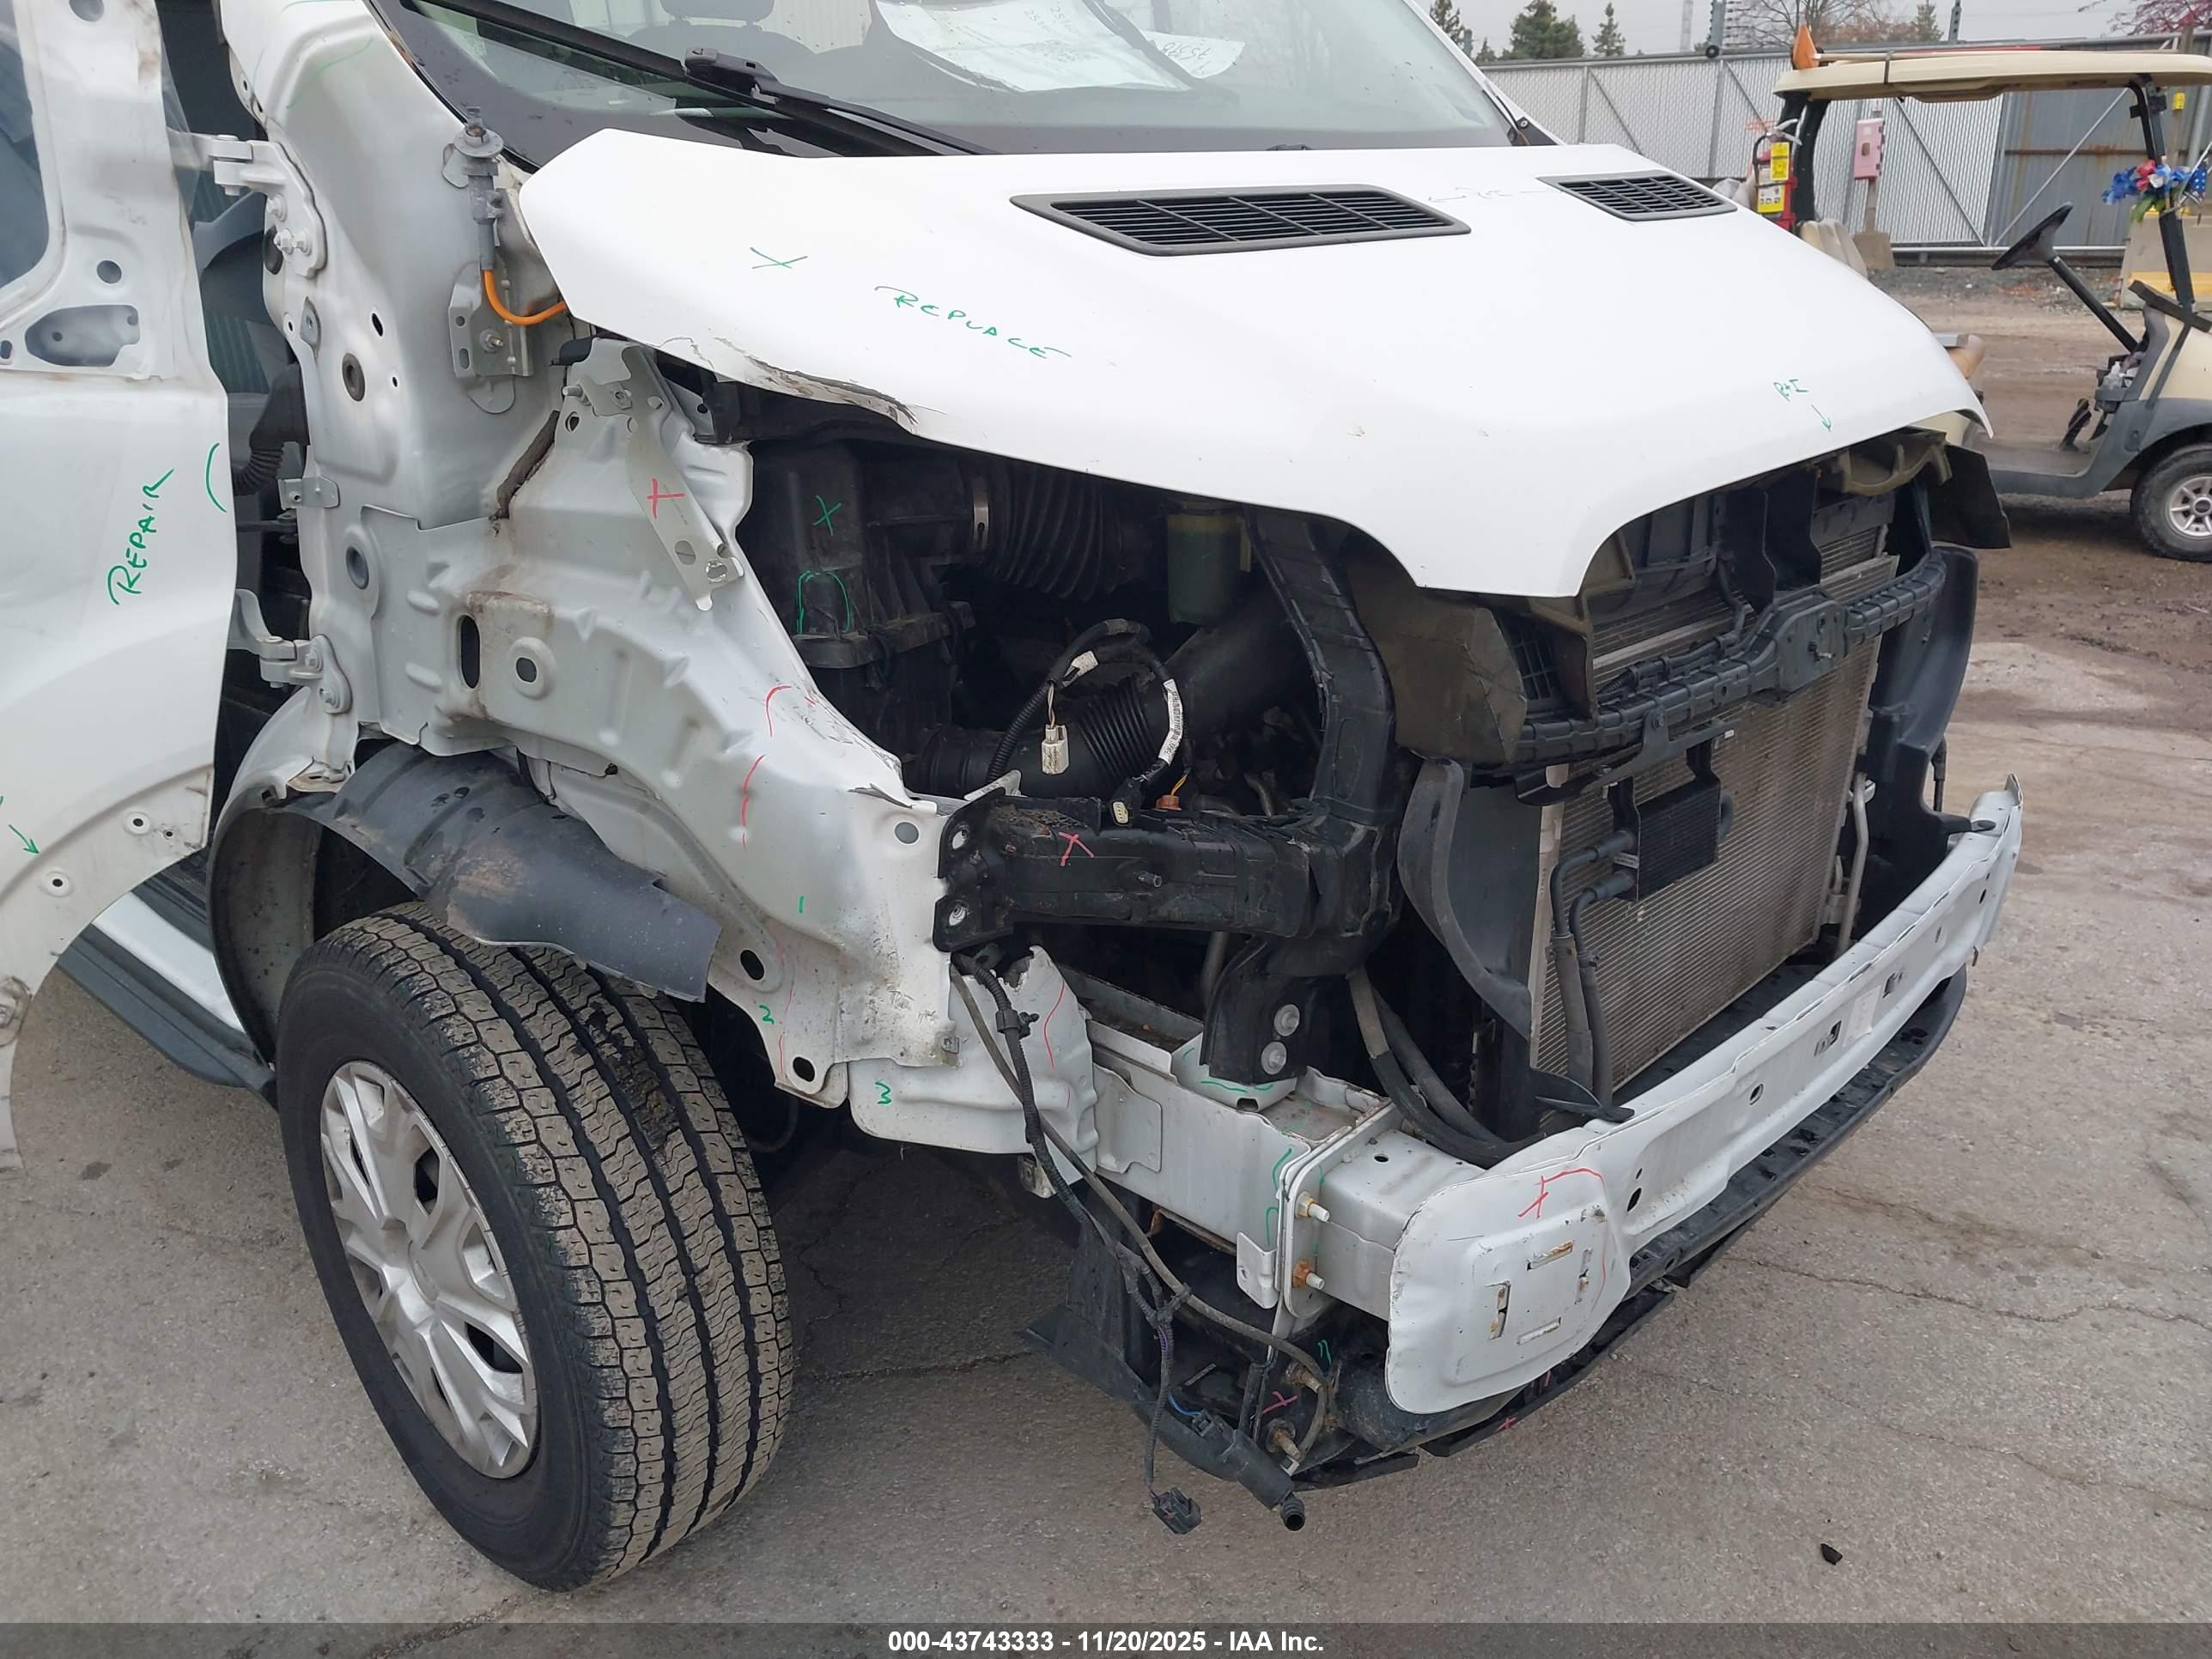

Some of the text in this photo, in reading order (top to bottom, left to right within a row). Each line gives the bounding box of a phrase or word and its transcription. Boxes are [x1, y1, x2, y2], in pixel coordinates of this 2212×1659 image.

[874, 286, 1073, 360] REPLACE
[107, 469, 173, 605] REPAIR
[759, 1005, 775, 1024] 2
[875, 1081, 892, 1104] 3
